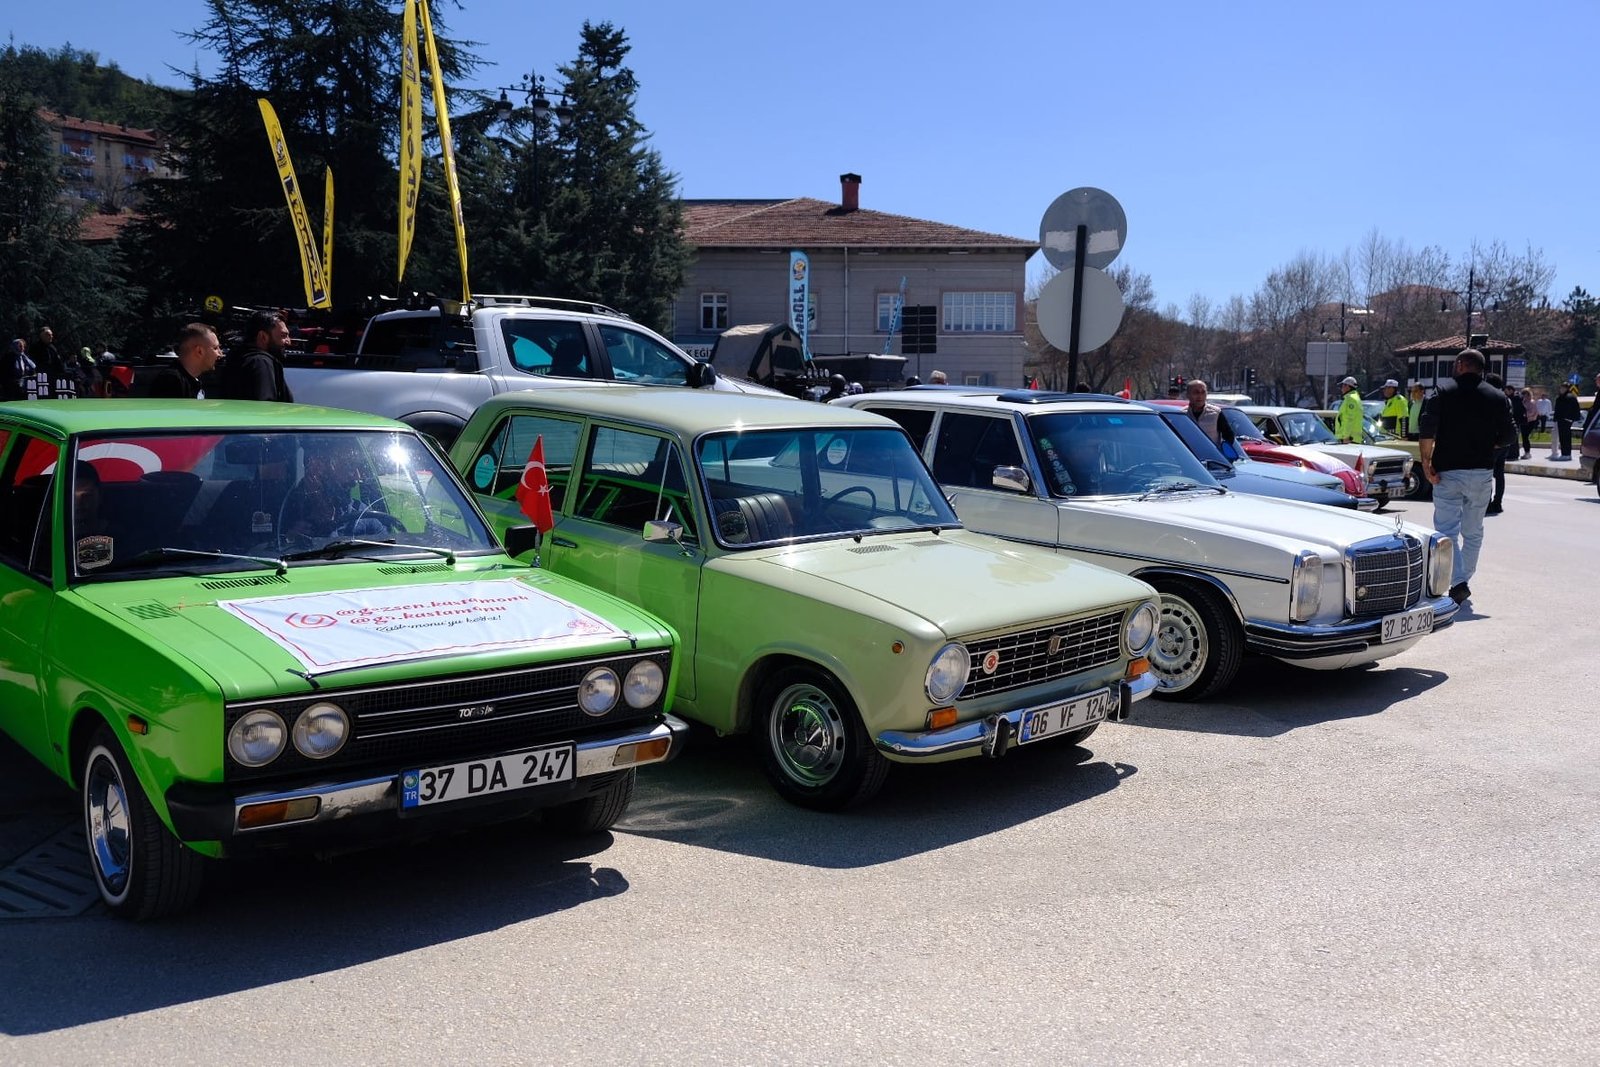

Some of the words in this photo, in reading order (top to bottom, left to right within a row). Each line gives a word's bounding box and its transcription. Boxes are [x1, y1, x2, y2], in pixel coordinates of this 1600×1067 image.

[694, 346, 712, 358] EĞİ
[1384, 619, 1396, 639] 37
[1400, 615, 1414, 635] BC
[1416, 611, 1433, 631] 230
[1030, 711, 1049, 736] 06
[1060, 704, 1077, 729] VF
[1085, 695, 1105, 721] 124
[404, 790, 418, 801] TR
[419, 767, 455, 801] 37
[467, 759, 508, 794] DA
[522, 748, 571, 785] 247
